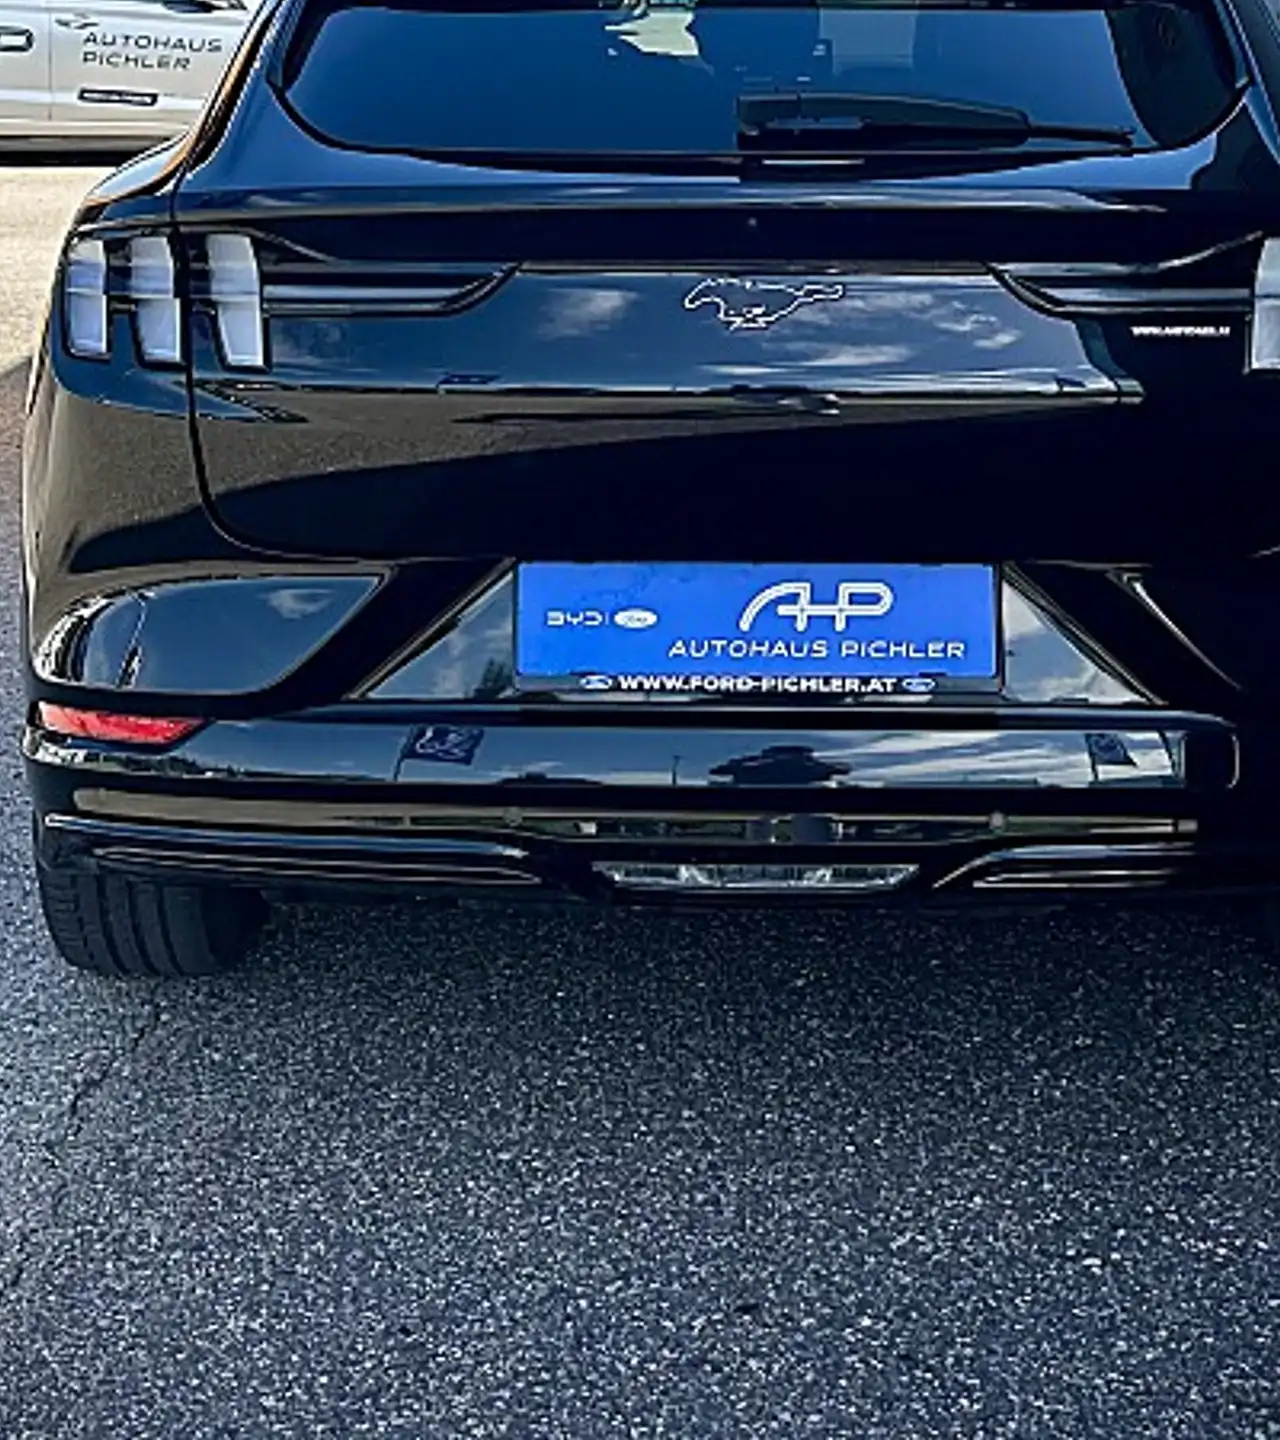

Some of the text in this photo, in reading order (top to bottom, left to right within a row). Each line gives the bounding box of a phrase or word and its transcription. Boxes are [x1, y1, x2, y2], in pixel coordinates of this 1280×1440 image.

[83, 31, 223, 53] AUTOHAUS
[82, 50, 191, 70] PICHLER
[668, 640, 966, 659] AUTOHAUS PICHLER
[618, 675, 897, 693] WWW.FORD-PICHLER.AT
